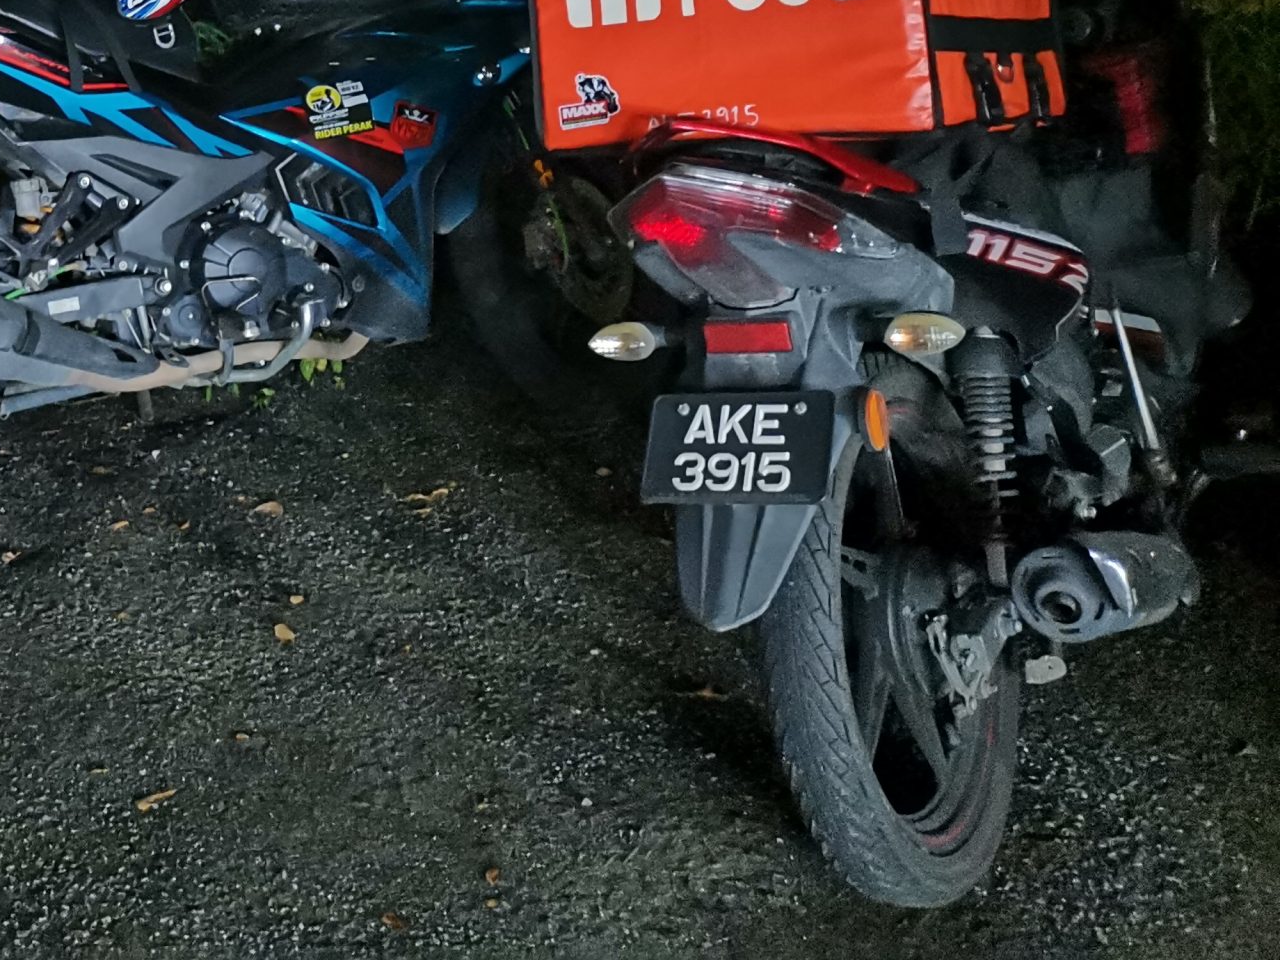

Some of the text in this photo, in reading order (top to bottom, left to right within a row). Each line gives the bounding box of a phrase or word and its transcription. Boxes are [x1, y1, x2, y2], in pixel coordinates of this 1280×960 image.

[562, 102, 608, 119] MAXX
[314, 126, 344, 140] RIDER
[343, 120, 373, 135] PERAK
[683, 403, 789, 445] AKE
[671, 450, 791, 492] 3915
